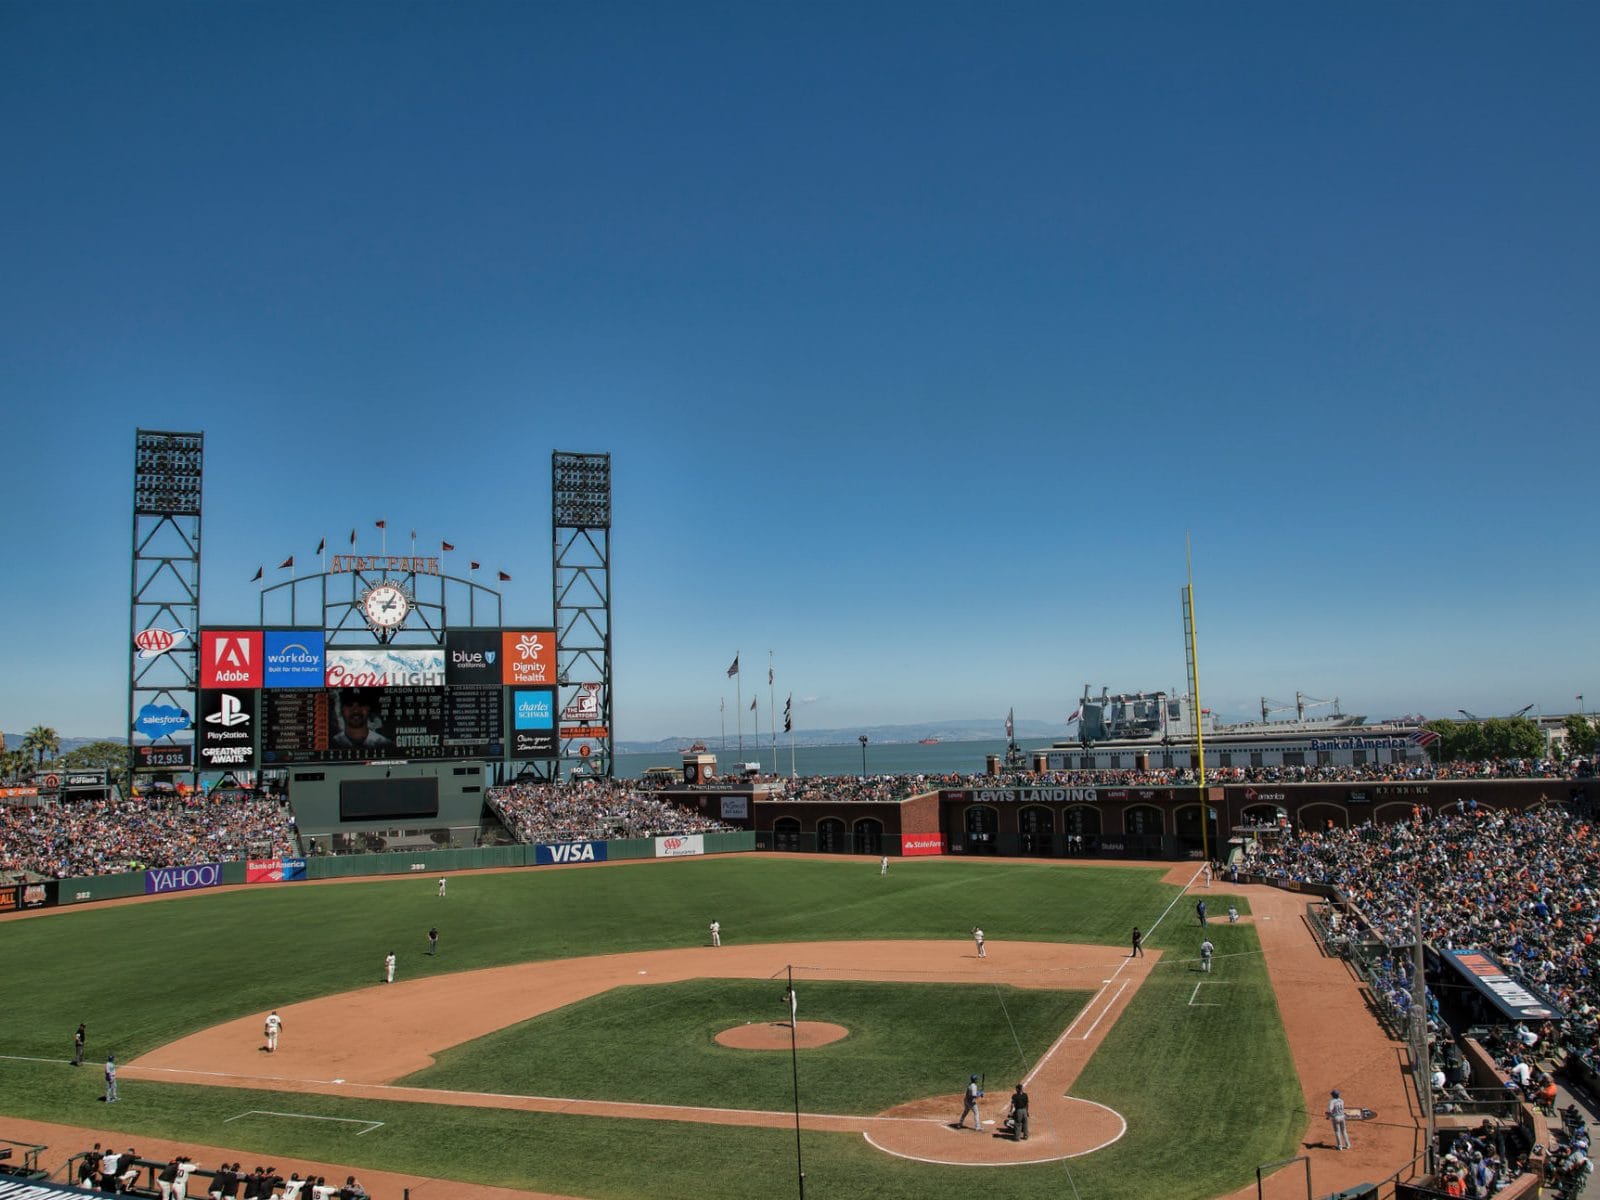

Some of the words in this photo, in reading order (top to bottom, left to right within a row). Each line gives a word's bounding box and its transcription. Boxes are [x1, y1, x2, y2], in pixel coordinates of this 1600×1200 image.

[331, 555, 374, 574] AT&T
[388, 556, 439, 576] PARK
[137, 630, 173, 648] AAA
[268, 653, 320, 664] workday
[453, 650, 482, 662] blue
[513, 662, 546, 673] Dignity
[216, 670, 249, 681] Adobe
[326, 665, 389, 686] Coors
[391, 672, 446, 686] LIGHT
[515, 673, 545, 682] Health
[519, 701, 548, 711] charles
[143, 714, 185, 725] salesforce
[396, 735, 440, 747] GUTIERREZ
[1311, 738, 1343, 750] Bank
[1343, 738, 1353, 749] of
[1355, 736, 1406, 749] America
[202, 747, 253, 756] GREATNESS
[146, 754, 184, 765] $12,935
[1020, 789, 1097, 801] LANDING
[664, 838, 681, 849] AAA
[547, 843, 594, 862] VISA
[249, 862, 265, 871] Bank
[266, 862, 275, 870] of
[275, 860, 305, 869] America
[151, 865, 219, 892] YAHOO!
